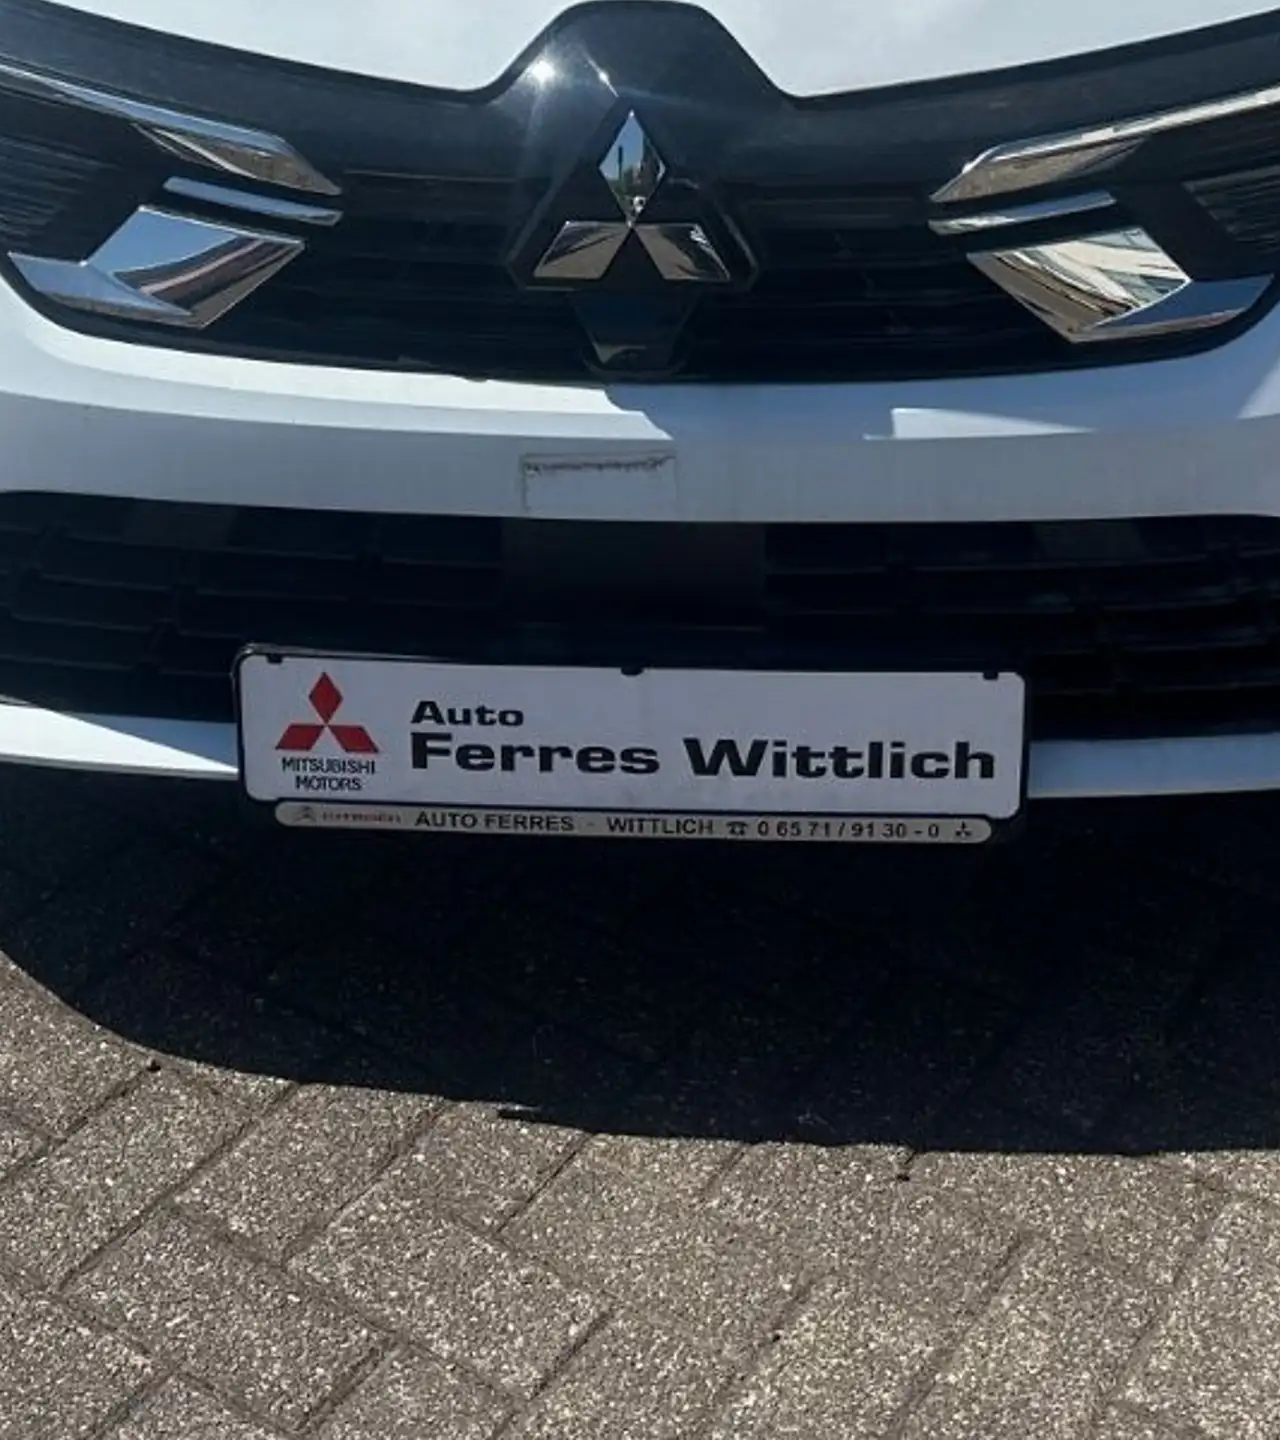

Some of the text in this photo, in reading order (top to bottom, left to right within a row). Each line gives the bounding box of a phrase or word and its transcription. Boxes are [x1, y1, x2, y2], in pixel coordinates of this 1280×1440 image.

[410, 700, 524, 726] Auto
[282, 757, 376, 776] MITSUBISHI
[410, 732, 995, 779] Ferres Wittlich
[294, 775, 363, 791] MOTORS
[414, 811, 479, 829] AUTO
[484, 813, 575, 832] FERRES
[606, 816, 715, 835] WITTLICH
